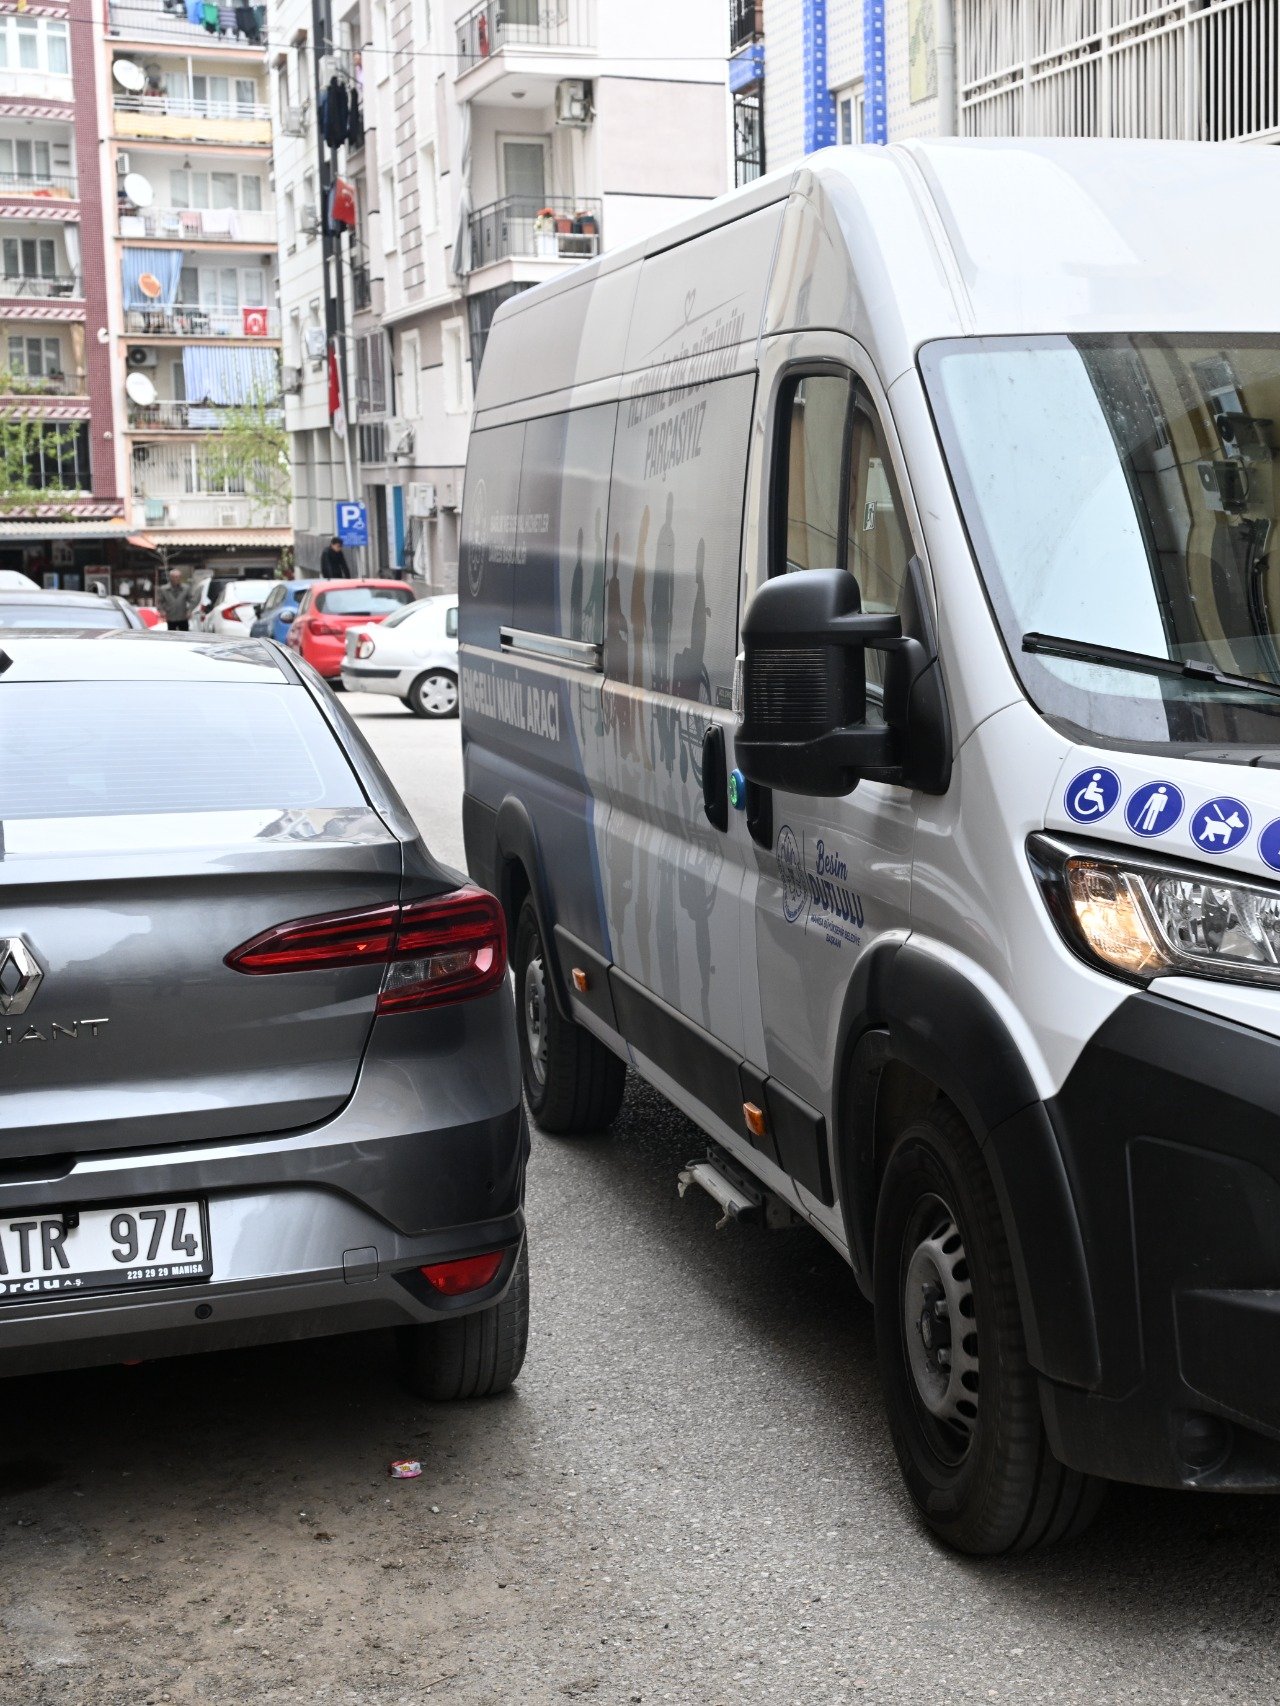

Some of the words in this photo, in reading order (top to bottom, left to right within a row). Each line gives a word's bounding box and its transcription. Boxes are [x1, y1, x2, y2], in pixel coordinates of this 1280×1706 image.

[643, 400, 707, 482] PARÇASIYIZ
[341, 505, 360, 528] P
[462, 662, 497, 719] ENGELLİ
[496, 668, 526, 730] NAKİL
[526, 685, 560, 742] ARACI
[816, 839, 848, 881] Besim
[806, 872, 864, 929] DUTLULU
[0, 1018, 109, 1044] IANT
[110, 1208, 198, 1263] 974
[126, 1270, 143, 1280] 229
[145, 1268, 156, 1278] 29
[158, 1267, 169, 1277] 29
